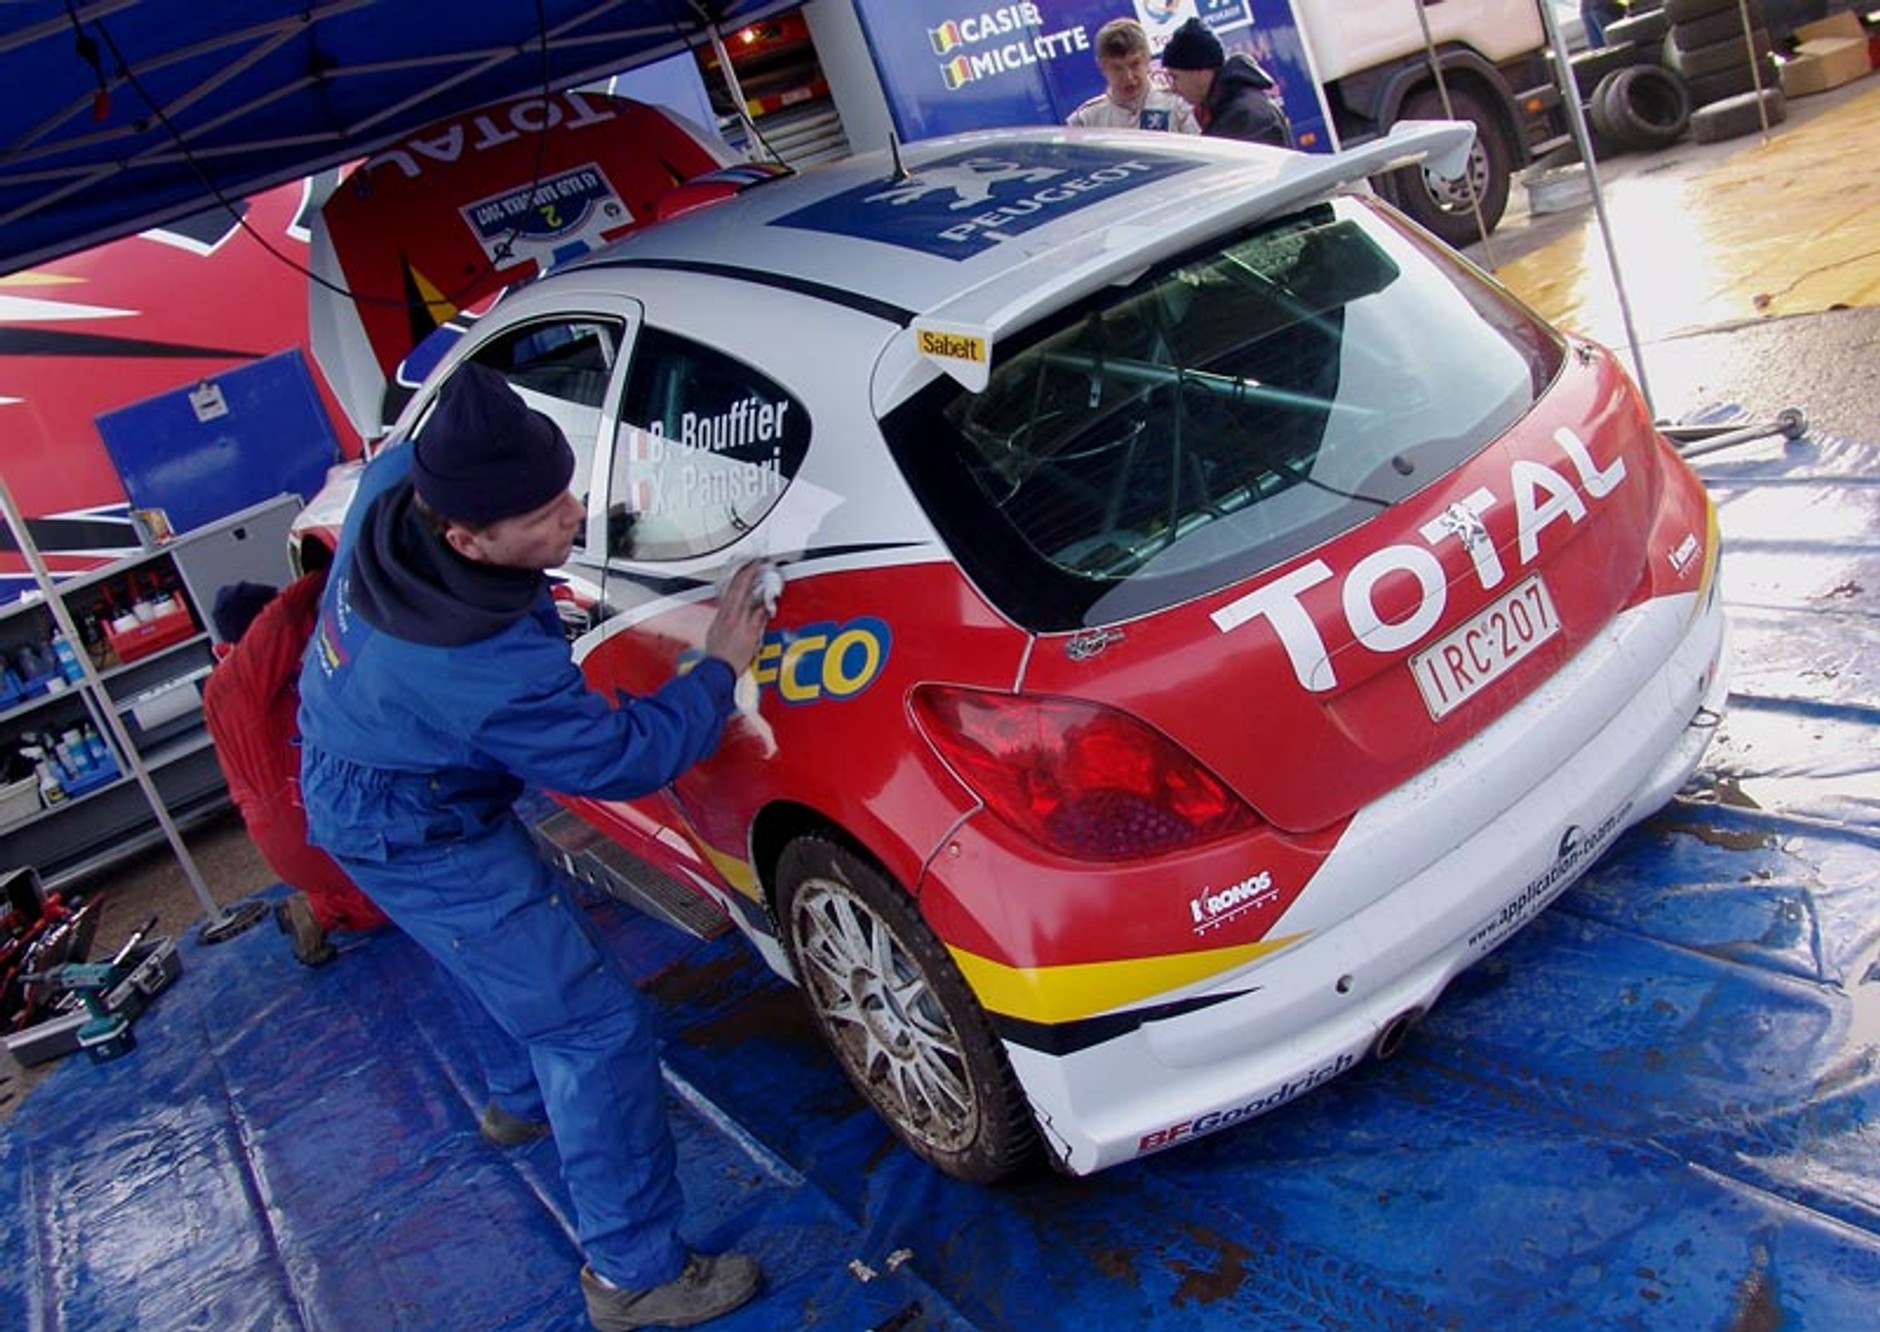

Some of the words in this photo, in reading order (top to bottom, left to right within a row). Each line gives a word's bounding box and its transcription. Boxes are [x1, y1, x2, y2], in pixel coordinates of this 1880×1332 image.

[364, 91, 616, 178] TOTAL
[538, 203, 563, 228] 2
[938, 160, 1152, 242] PEUGEOT
[923, 331, 977, 361] Sabelt
[682, 398, 788, 453] Bouffier
[680, 427, 781, 509] Panseri
[1210, 426, 1626, 692] TOTAL
[1190, 870, 1273, 922] KRONOS
[1138, 1054, 1353, 1151] BFGoodrich
